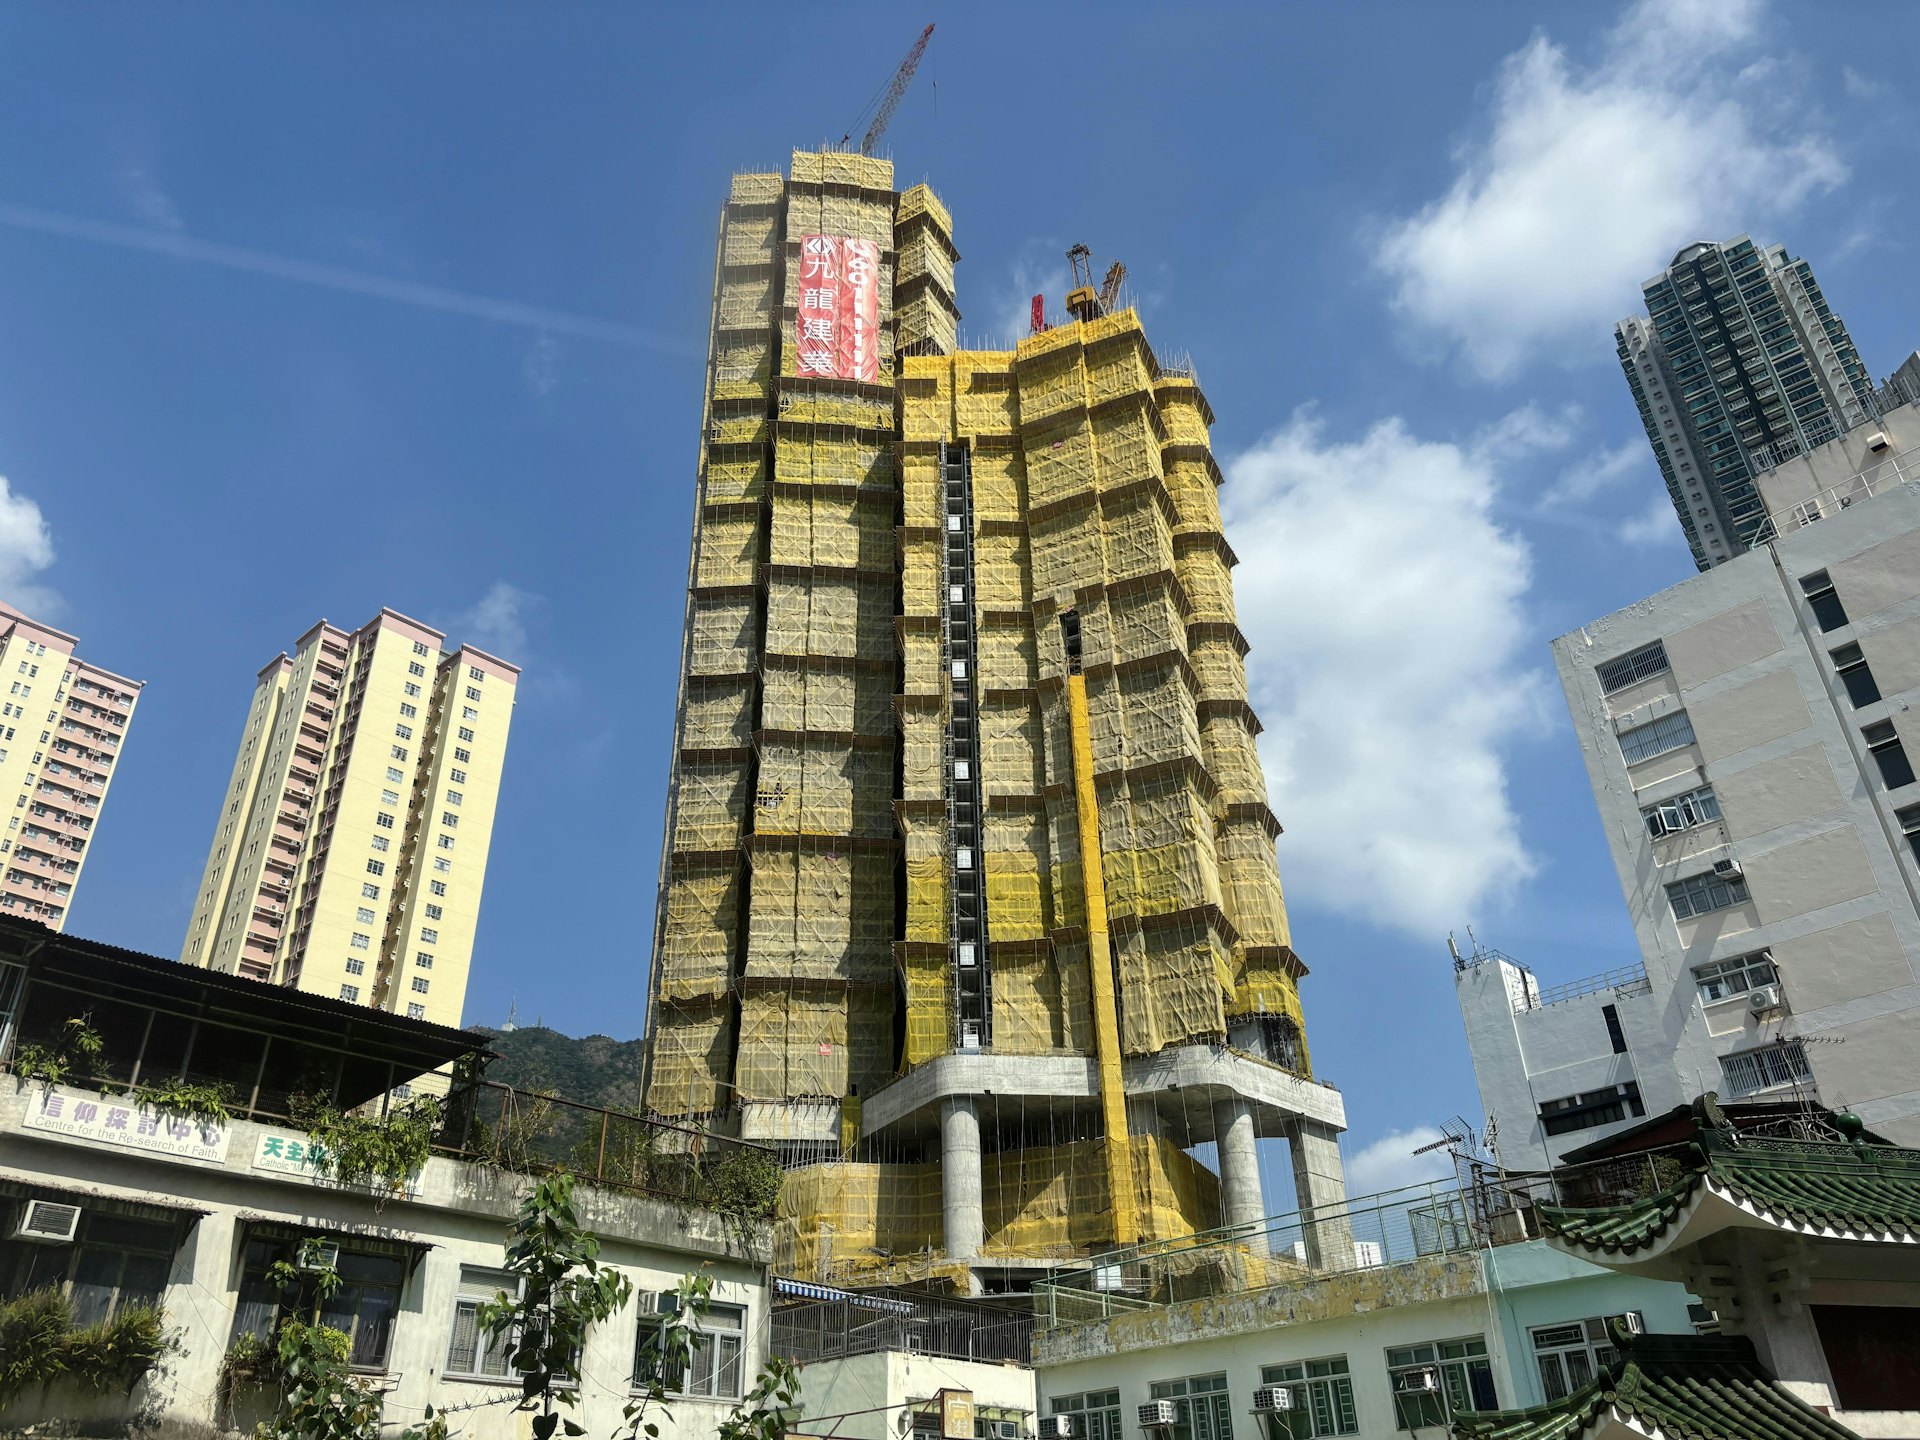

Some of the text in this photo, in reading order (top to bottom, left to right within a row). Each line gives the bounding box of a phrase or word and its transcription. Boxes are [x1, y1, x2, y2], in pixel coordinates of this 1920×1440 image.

[802, 257, 835, 373] 九龍建業
[35, 1116, 218, 1159] Centre for the Re-search of Faith
[40, 1095, 221, 1147] 信仰探討中心
[259, 1156, 290, 1171] Catholic
